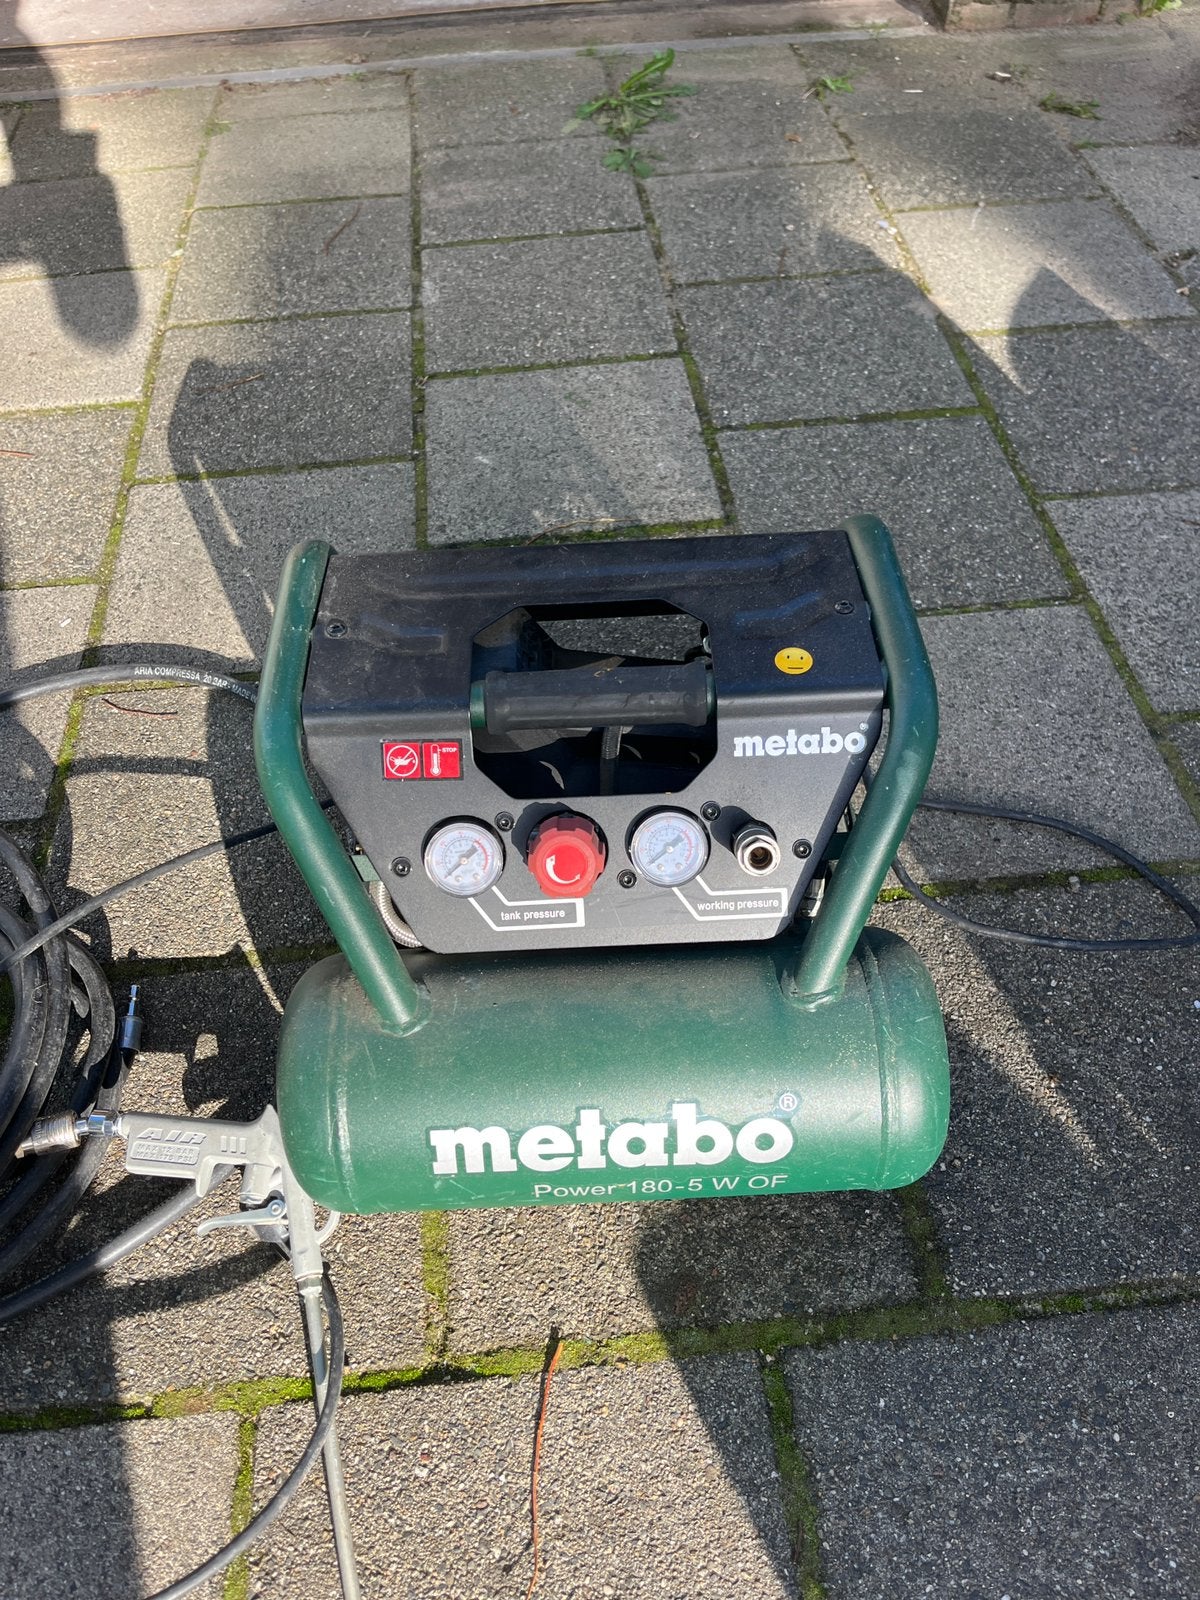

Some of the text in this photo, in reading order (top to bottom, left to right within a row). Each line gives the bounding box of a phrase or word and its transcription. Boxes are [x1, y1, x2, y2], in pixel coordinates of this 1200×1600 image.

[134, 666, 153, 676] ARIA
[154, 666, 200, 681] COMPRESSA
[697, 899, 780, 912] working pressure
[500, 909, 566, 922] tank pressure
[137, 1128, 207, 1144] AIR
[534, 1174, 789, 1199] Power 180-5 W OF
